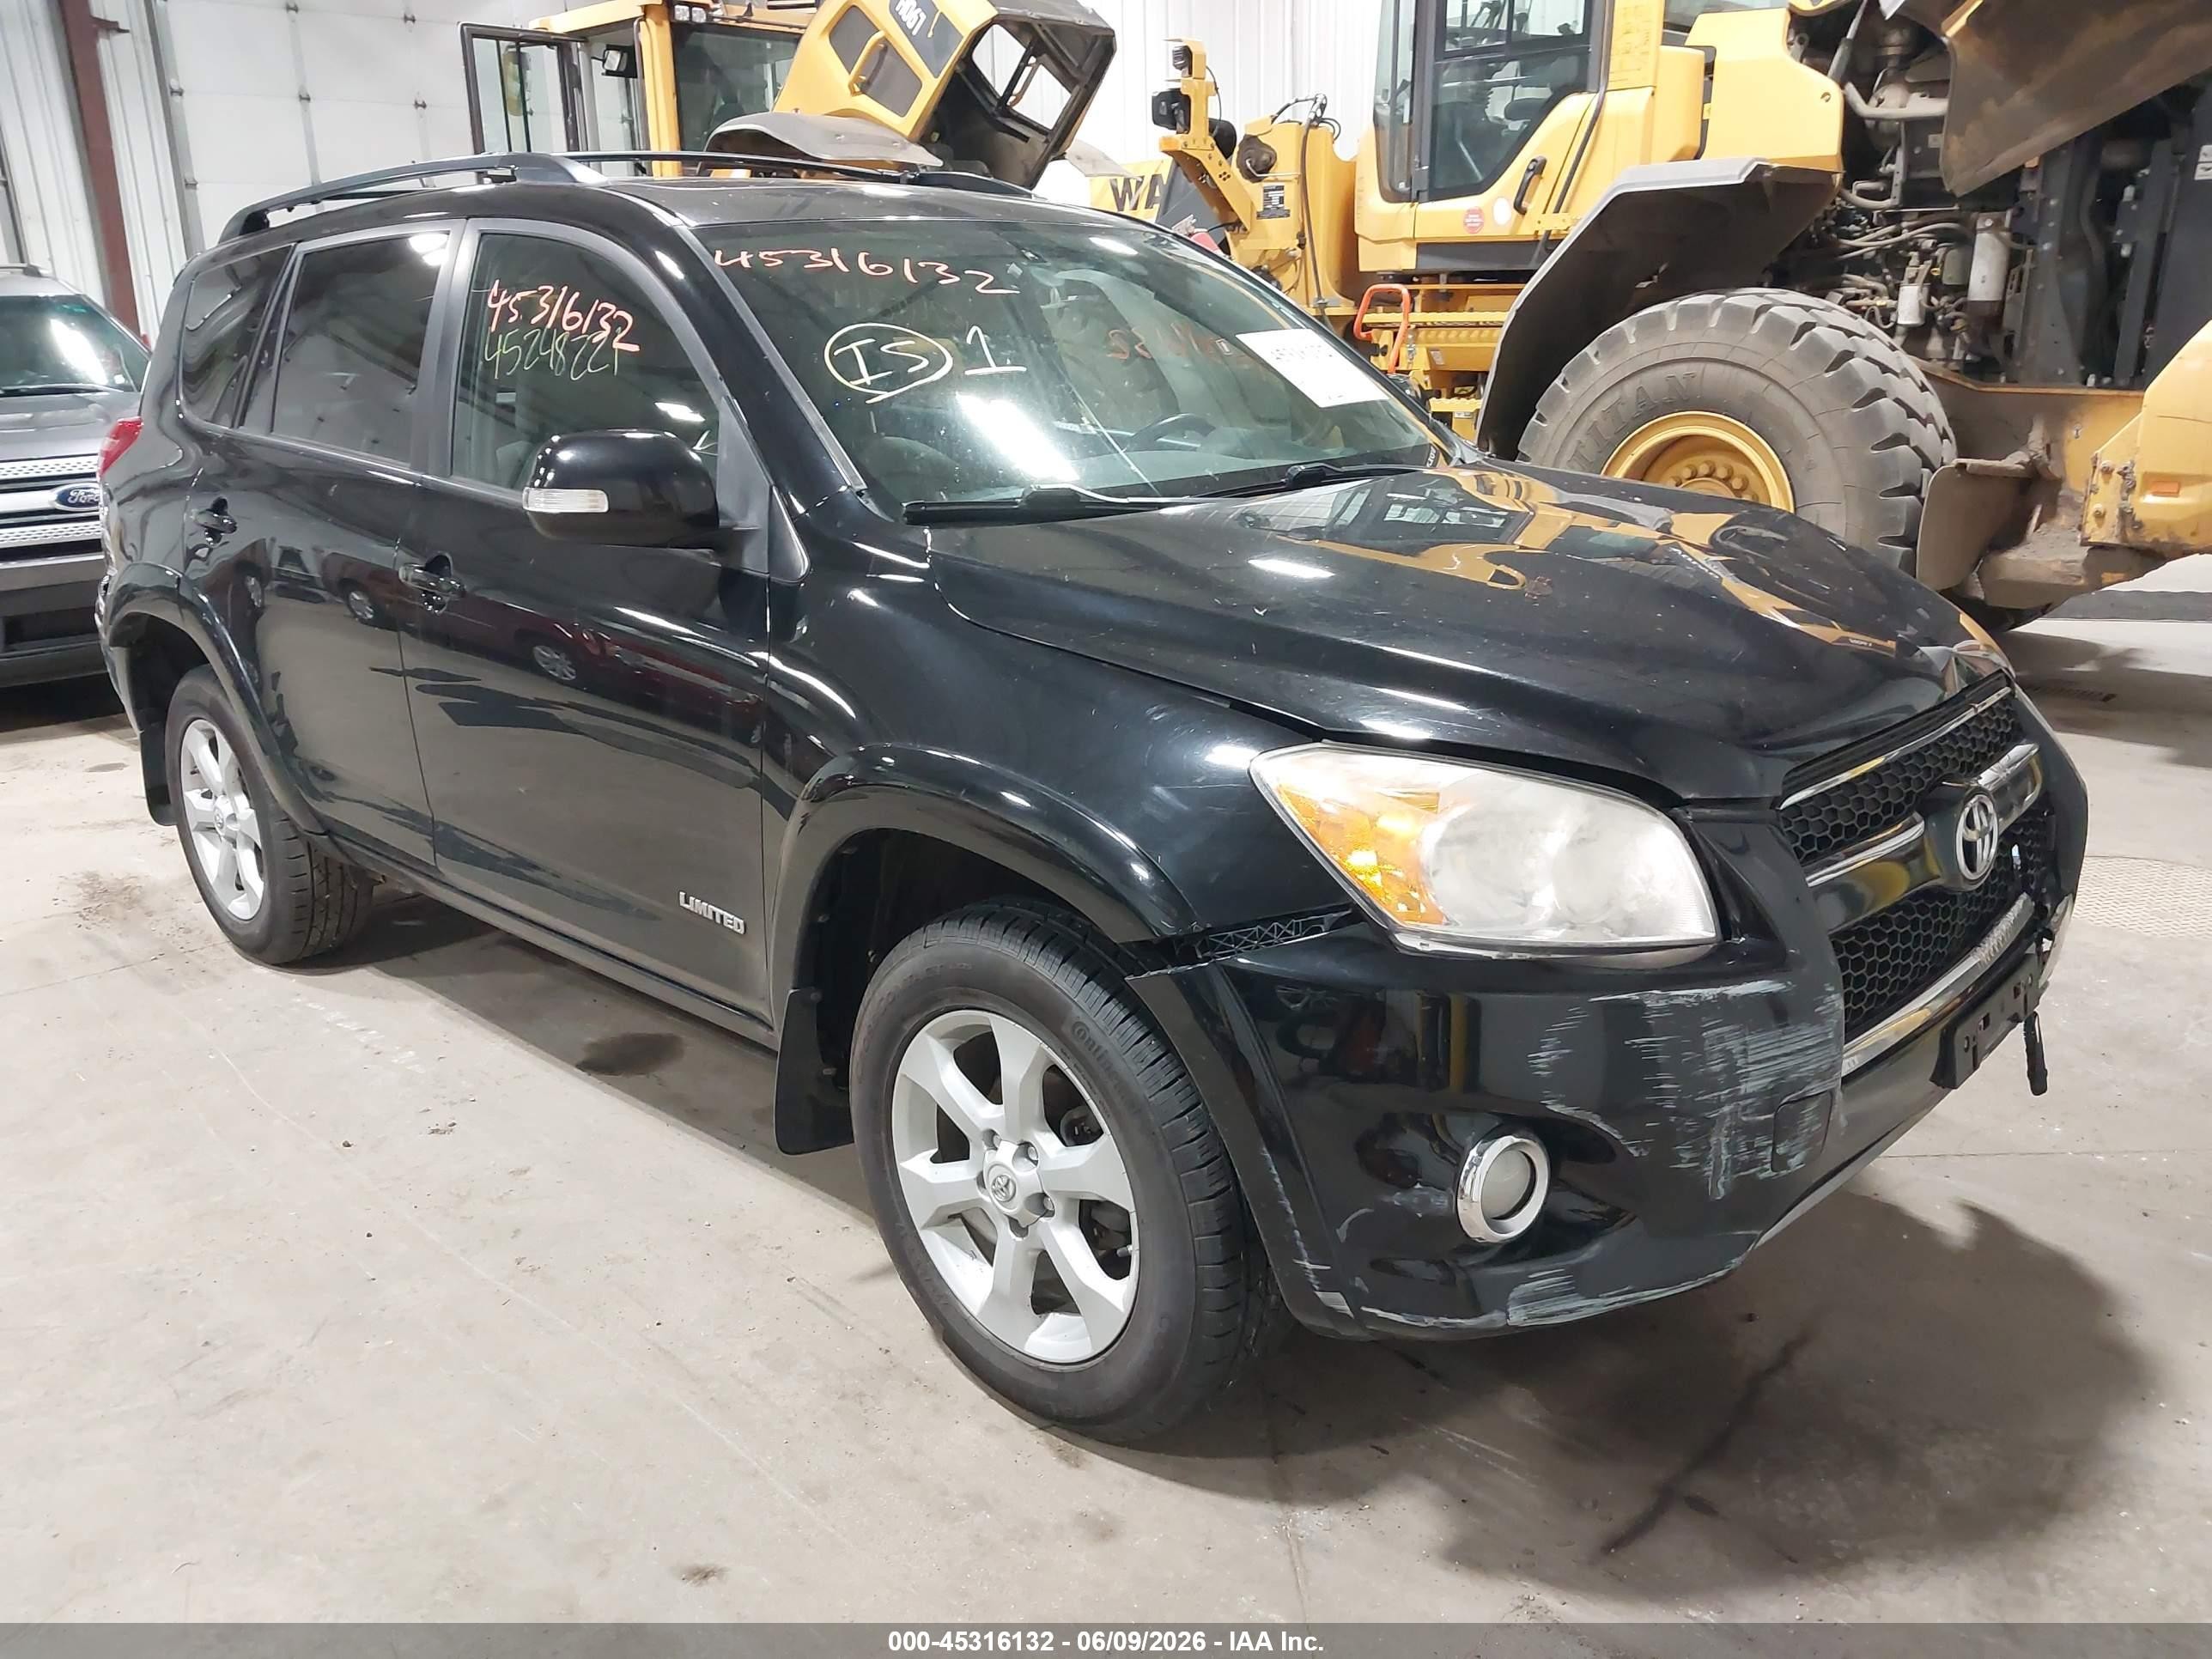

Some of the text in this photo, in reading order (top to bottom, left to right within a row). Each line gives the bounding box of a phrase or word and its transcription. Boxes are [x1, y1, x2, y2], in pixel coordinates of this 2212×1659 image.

[714, 247, 1020, 295] 45316132
[487, 279, 641, 352] 45316132
[964, 325, 1027, 375] 1
[679, 890, 745, 935] LIMITED
